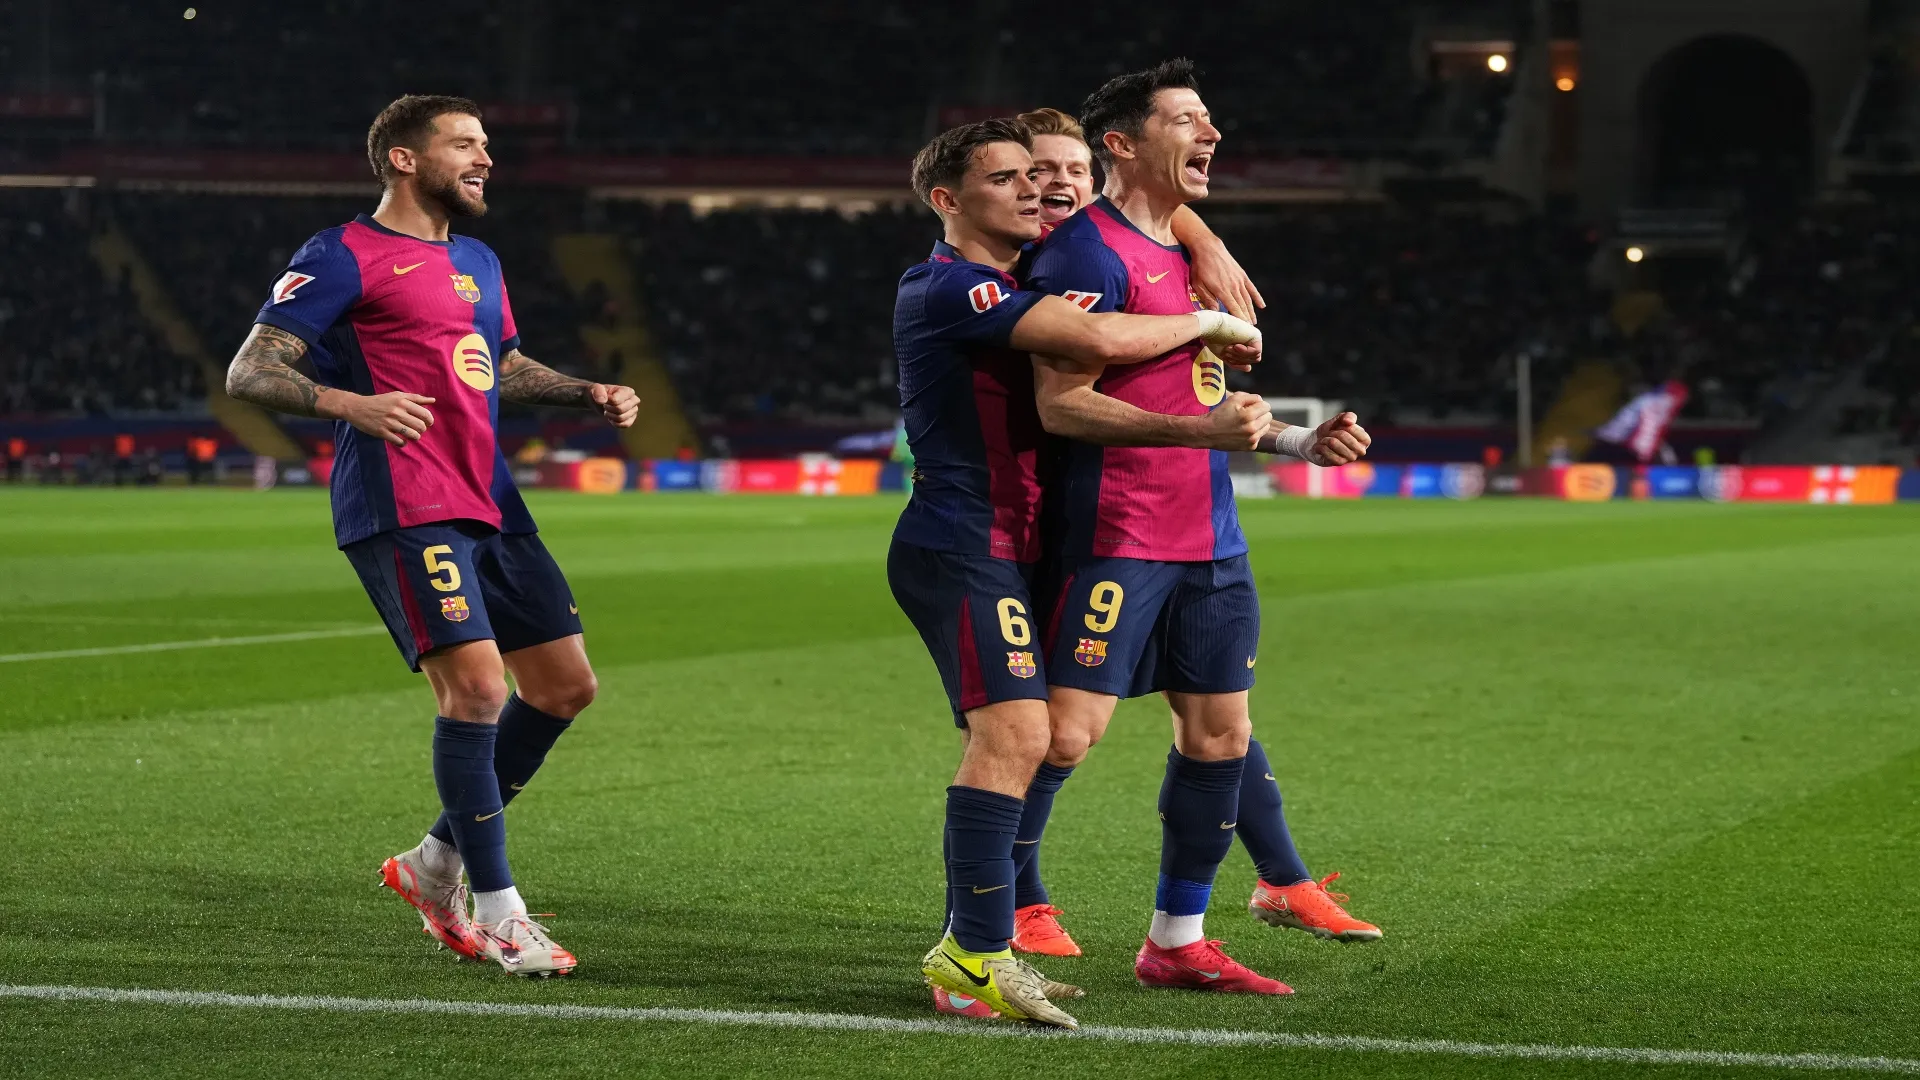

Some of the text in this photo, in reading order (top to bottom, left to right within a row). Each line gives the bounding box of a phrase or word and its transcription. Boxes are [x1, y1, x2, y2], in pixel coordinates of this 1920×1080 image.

[423, 544, 461, 592] 5
[997, 597, 1031, 646] 6
[1084, 581, 1124, 633] 9
